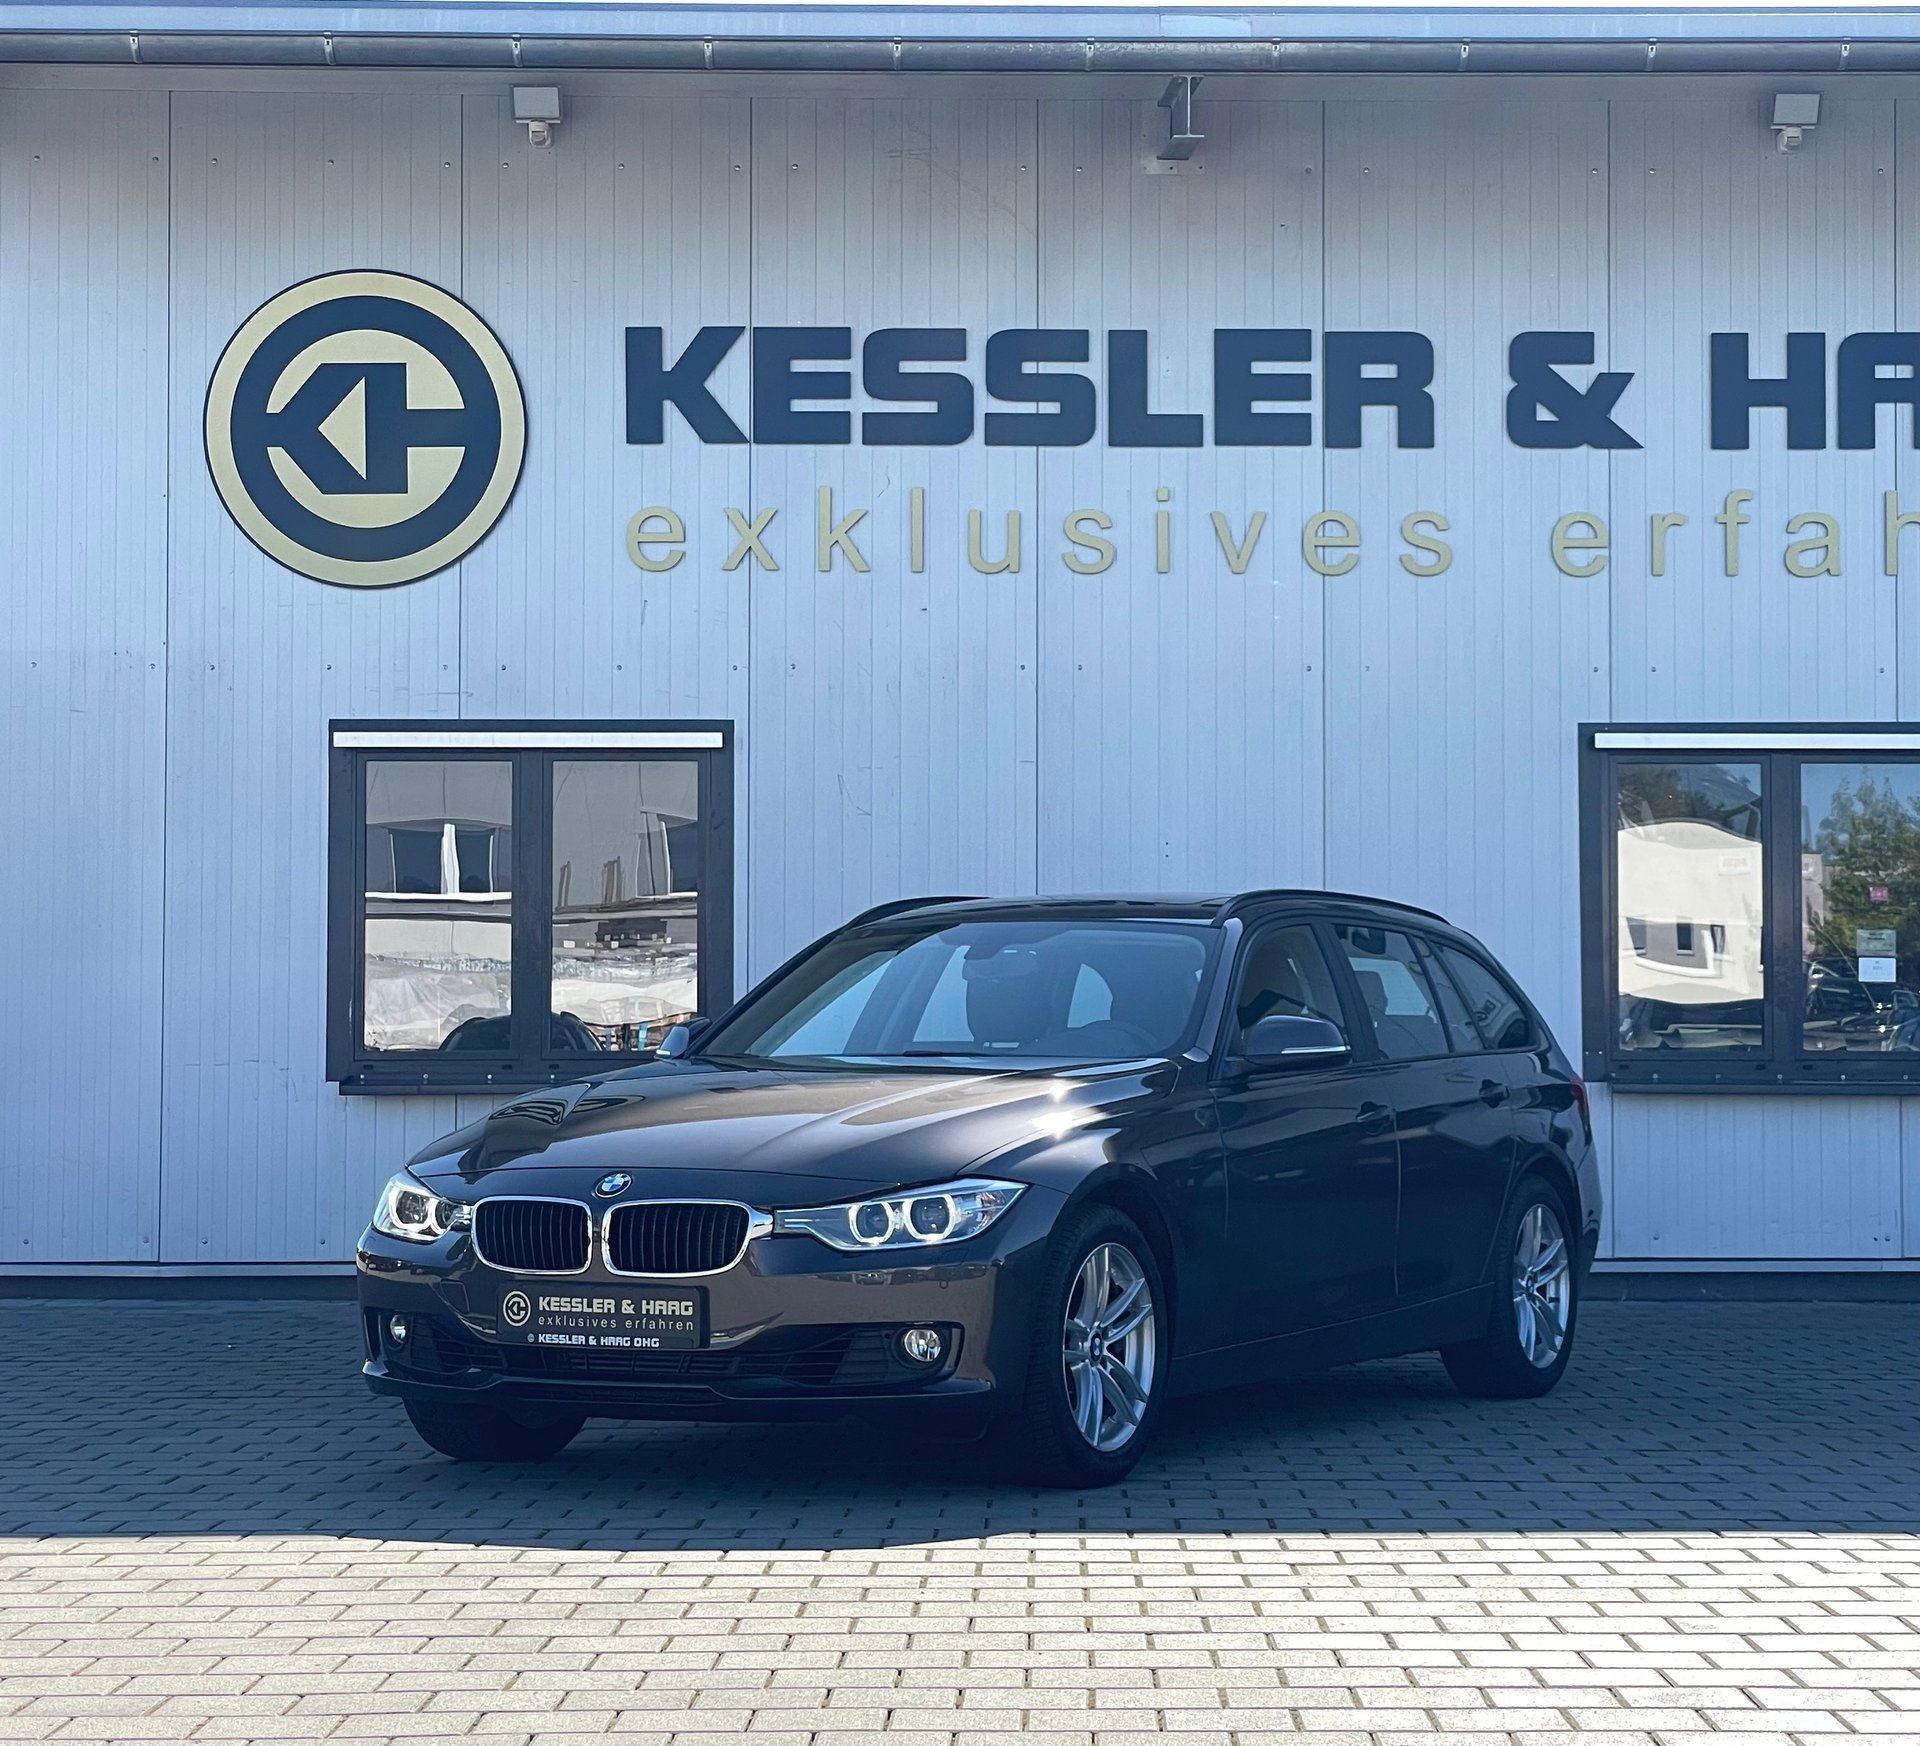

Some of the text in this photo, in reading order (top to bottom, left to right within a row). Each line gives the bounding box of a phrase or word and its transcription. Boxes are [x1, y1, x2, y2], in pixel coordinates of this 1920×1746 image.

[625, 326, 1435, 450] KESSLER
[1506, 331, 1645, 450] &
[625, 485, 1453, 578] exklusives
[538, 1296, 694, 1316] KESSLER & HAAG
[538, 1315, 694, 1331] exklusives erfahren
[538, 1333, 660, 1348] KESSLER & HAAG OHG
